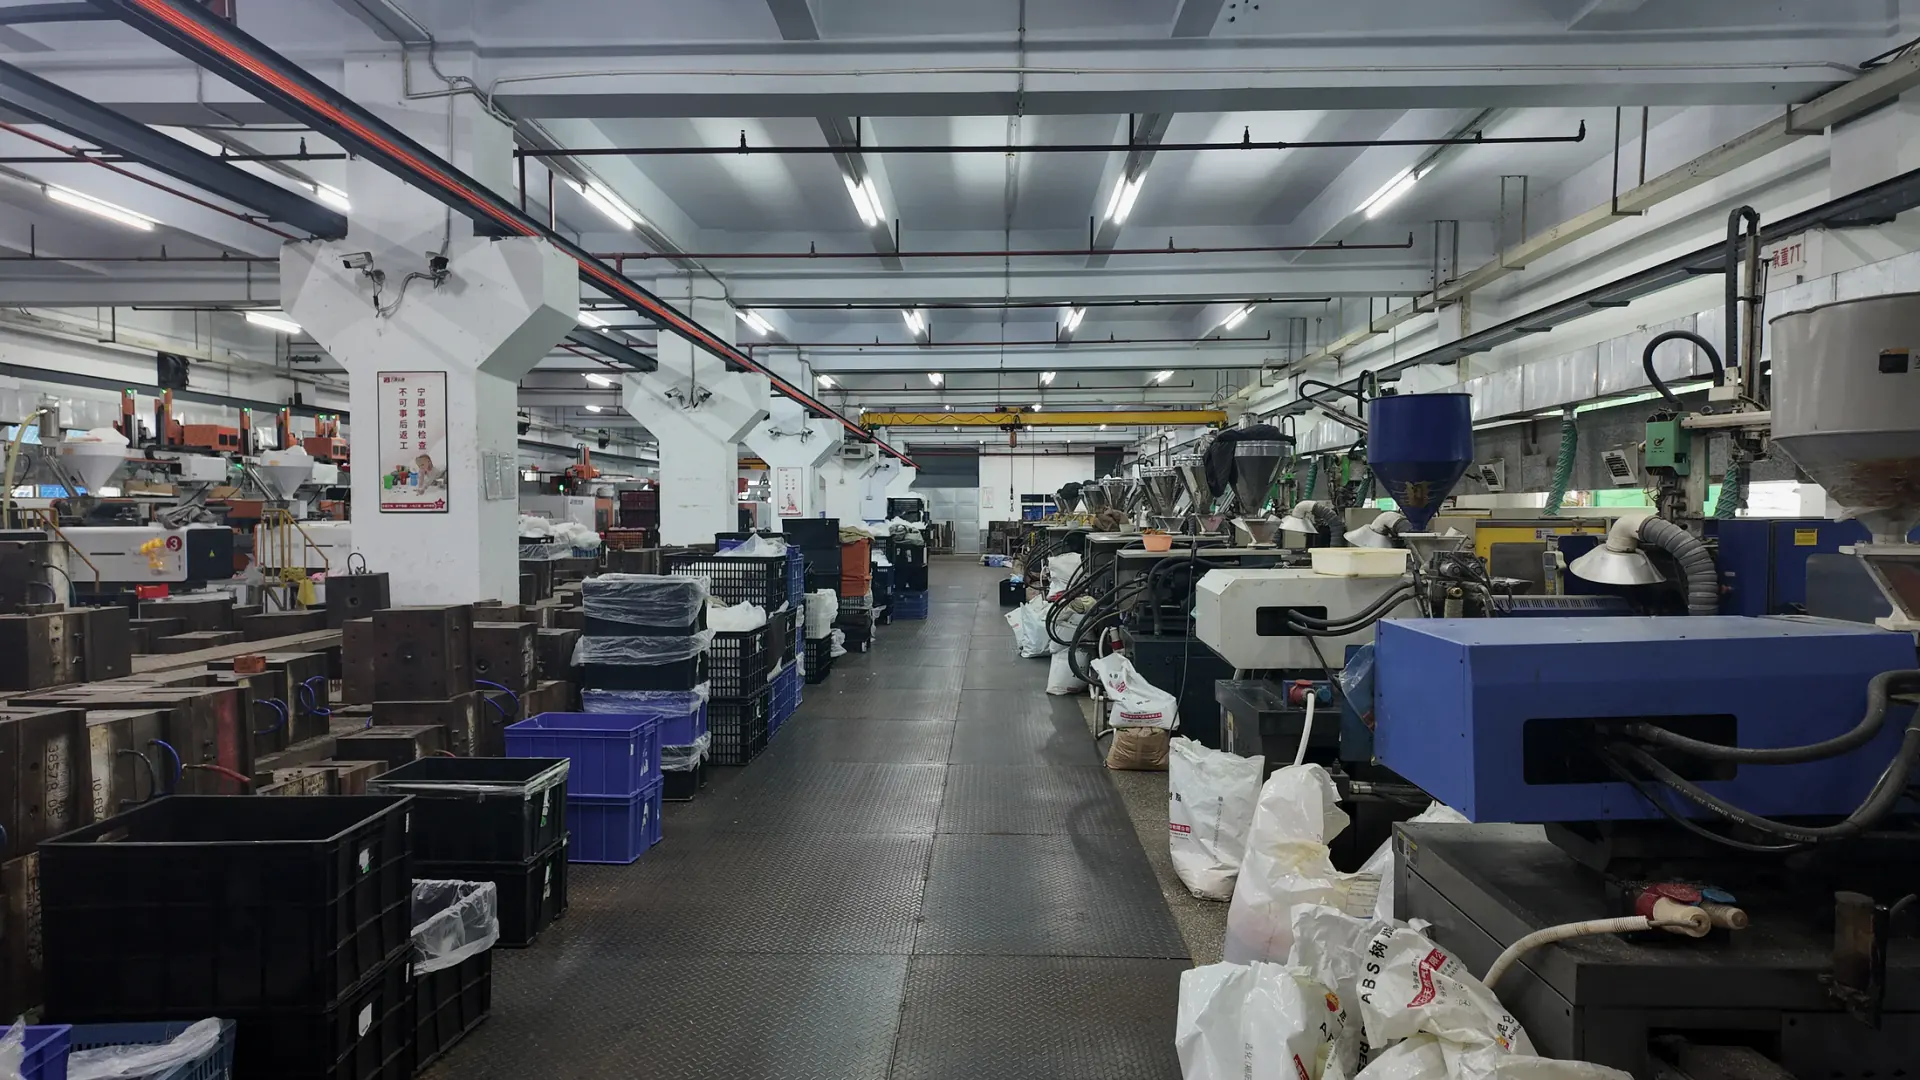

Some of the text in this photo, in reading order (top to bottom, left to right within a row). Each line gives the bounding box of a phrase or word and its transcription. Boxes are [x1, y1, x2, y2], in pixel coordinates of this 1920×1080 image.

[1772, 243, 1802, 269] 承重7T
[399, 387, 408, 450] 不可事后返工
[417, 387, 427, 450] 宁愿事前检查
[171, 538, 179, 551] 3
